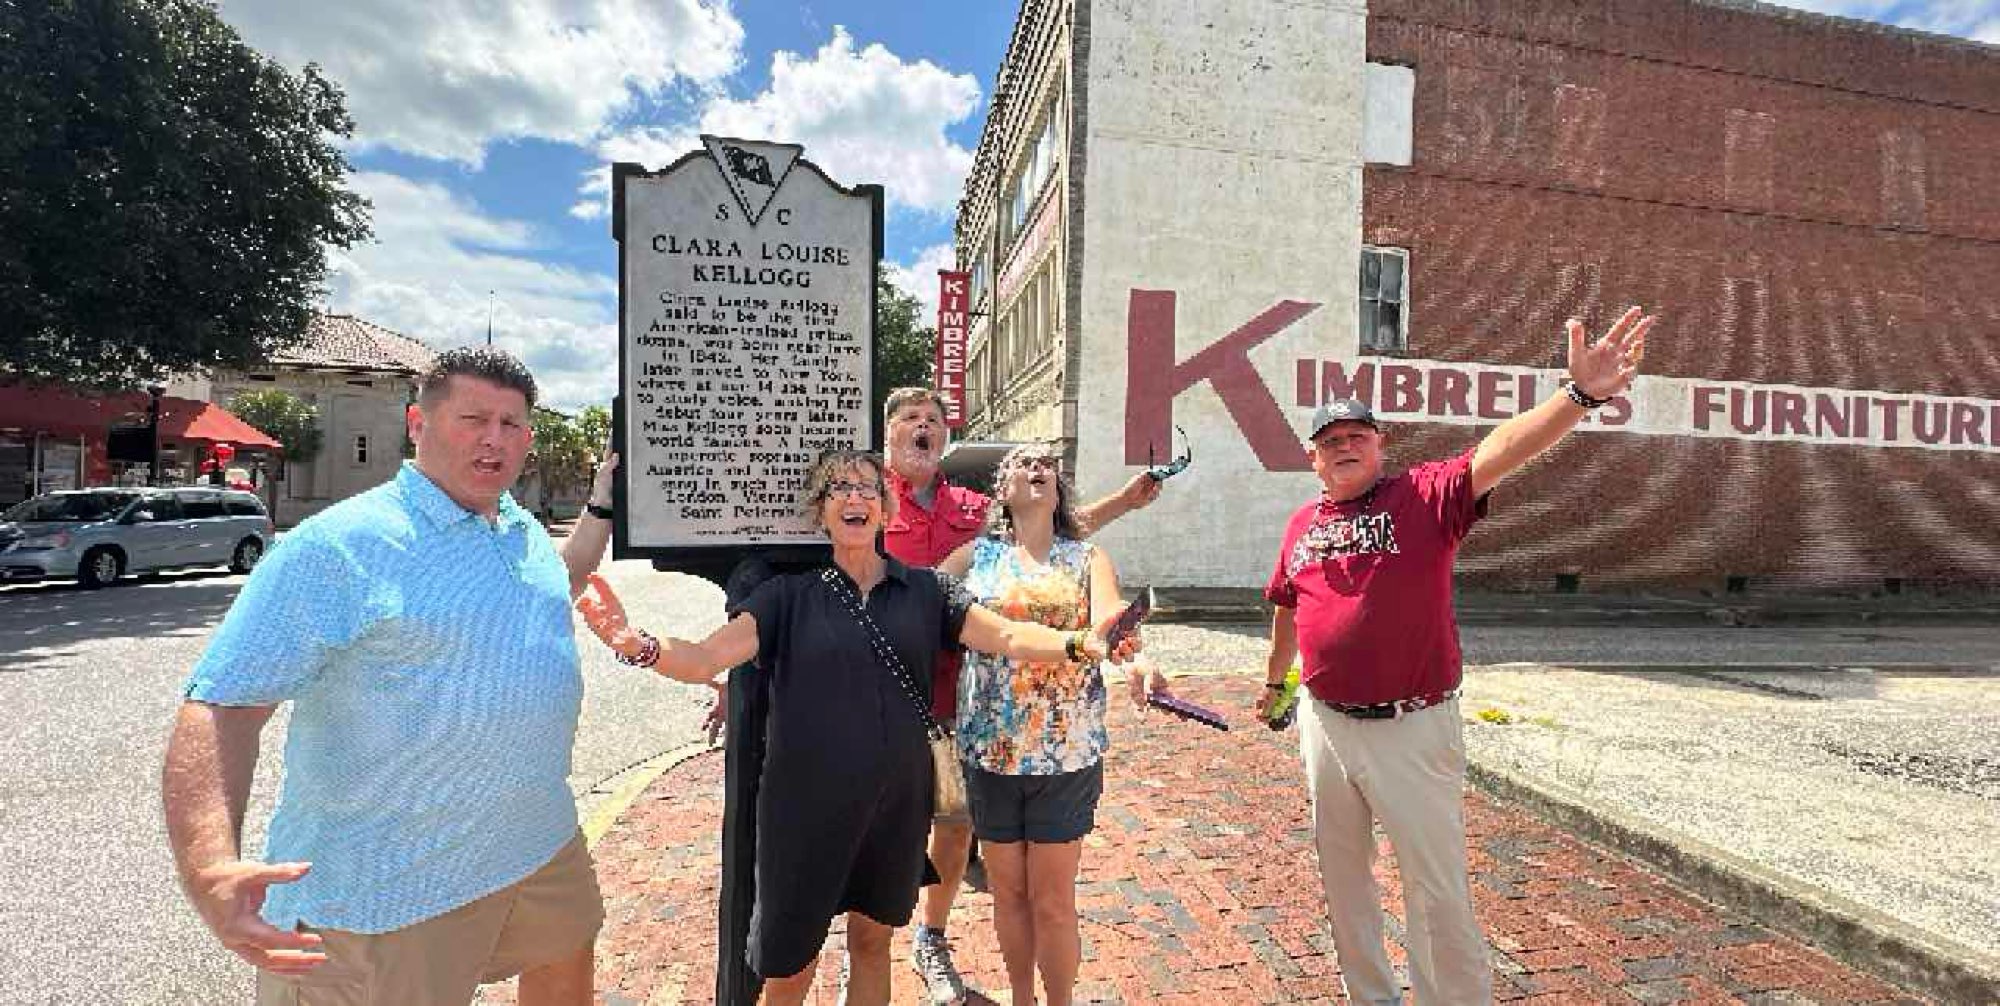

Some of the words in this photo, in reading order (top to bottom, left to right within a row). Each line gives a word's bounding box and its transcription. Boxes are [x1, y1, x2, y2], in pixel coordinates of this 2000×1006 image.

[714, 202, 729, 221] S
[776, 207, 791, 226] C
[652, 233, 741, 257] CLARA
[761, 241, 850, 266] LOUISE
[692, 263, 810, 288] KELLOGG
[660, 292, 706, 307] Clara
[718, 294, 770, 310] Louise
[780, 298, 839, 316] Kellogg
[665, 306, 698, 320] said
[712, 309, 726, 322] to
[737, 308, 758, 323] be
[769, 312, 793, 325] the
[805, 310, 836, 326] first
[649, 318, 798, 339] American-trained
[809, 328, 854, 342] prima
[703, 340, 732, 351] was
[741, 338, 780, 351] born
[787, 343, 823, 354] near
[828, 344, 862, 356] here
[662, 350, 681, 362] in
[751, 352, 780, 366] Her
[791, 354, 840, 370] family
[643, 362, 682, 376] later
[691, 364, 744, 379] moved
[753, 367, 770, 379] to
[778, 369, 810, 379] New
[637, 378, 687, 392] where
[696, 380, 711, 392] at
[758, 380, 773, 393] 14
[781, 383, 808, 395] she
[816, 384, 862, 398] began
[637, 393, 654, 405] to
[664, 393, 708, 408] study
[774, 396, 830, 411] making
[837, 395, 862, 410] her
[655, 405, 701, 420] debut
[709, 407, 745, 420] four
[755, 411, 798, 424] years
[809, 408, 848, 423] later.
[643, 421, 680, 433] Miss
[687, 421, 748, 438] Kellogg
[756, 424, 792, 435] soon
[799, 424, 858, 436] became
[646, 433, 695, 448] world
[777, 436, 789, 448] A
[799, 437, 855, 453] leading
[666, 451, 738, 464] operatic
[749, 452, 811, 466] soprano
[646, 464, 713, 476] America
[724, 464, 751, 476] and
[661, 479, 698, 493] sang
[706, 478, 721, 490] in
[730, 478, 767, 490] such
[680, 505, 722, 520] Saint
